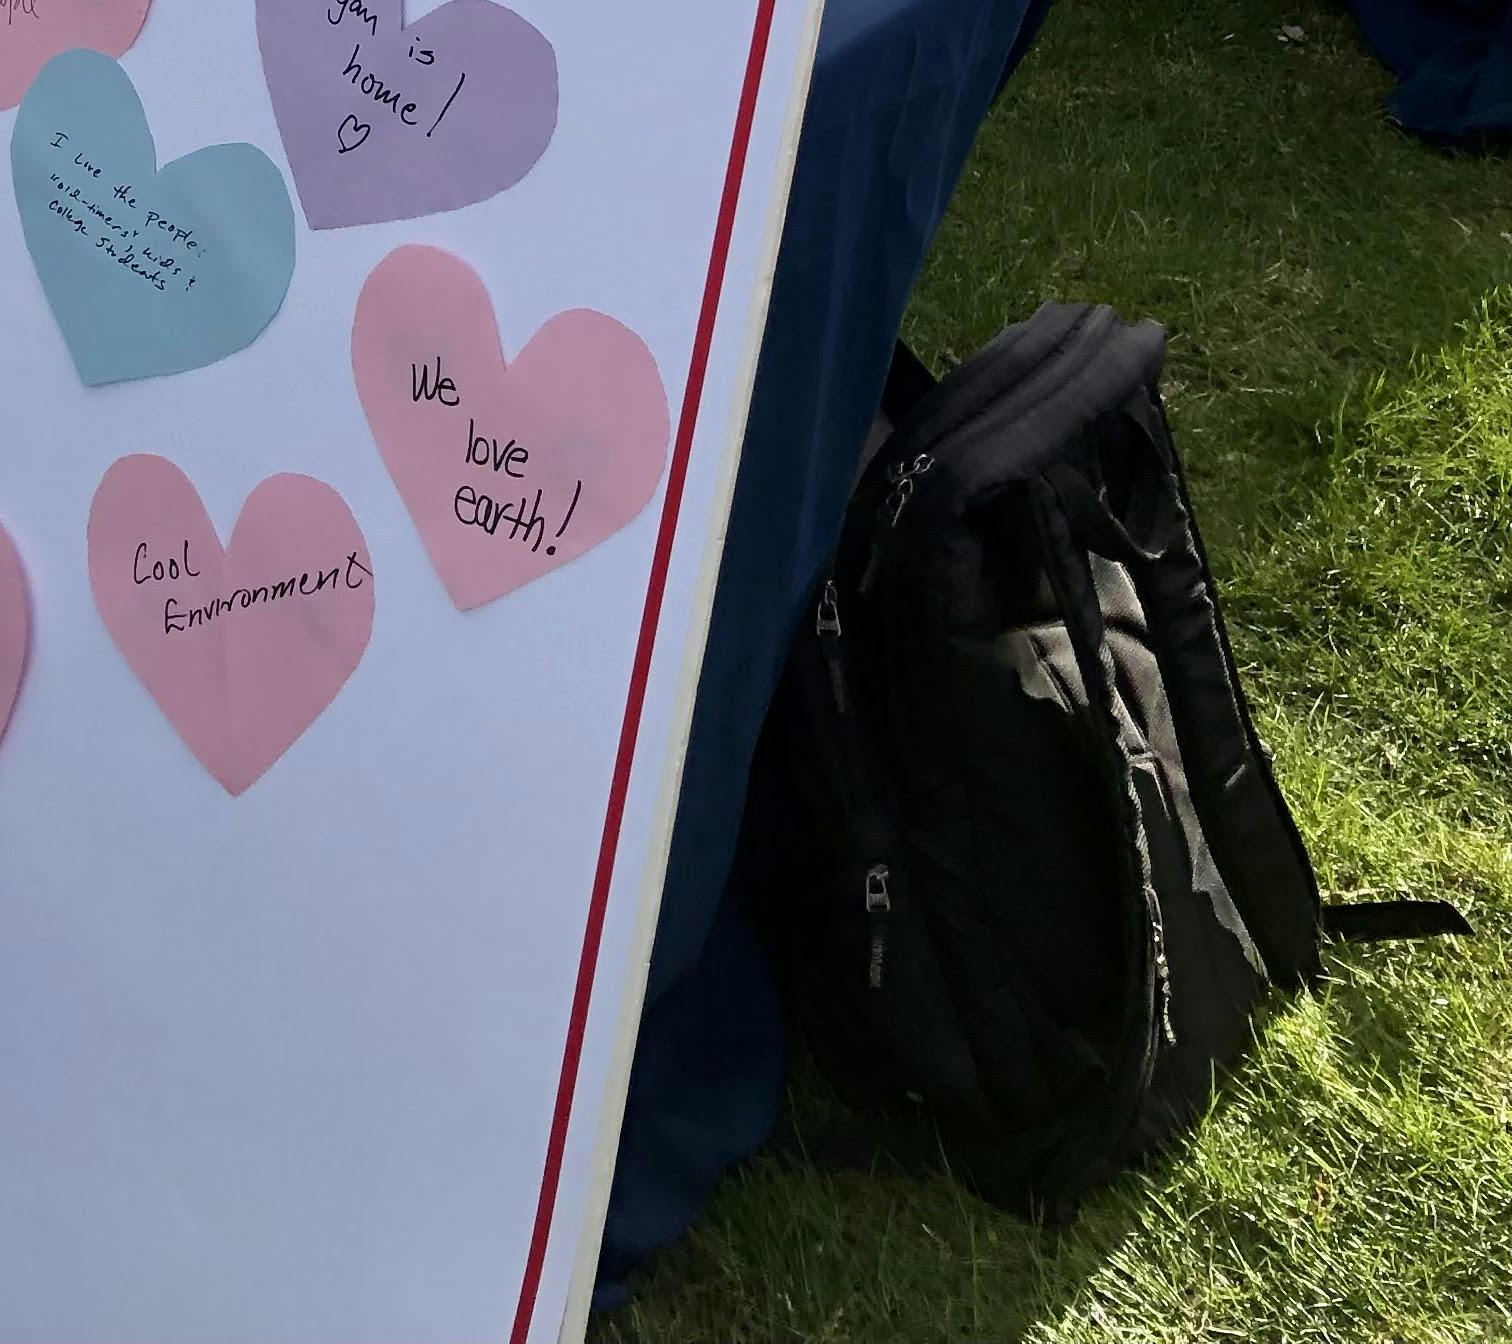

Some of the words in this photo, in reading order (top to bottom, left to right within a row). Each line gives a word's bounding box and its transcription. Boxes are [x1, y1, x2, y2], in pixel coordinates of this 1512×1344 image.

[408, 36, 436, 66] is
[342, 43, 467, 138] home!
[50, 132, 69, 149] I
[113, 185, 137, 209] the
[412, 355, 460, 407] We
[465, 418, 530, 478] love
[454, 479, 582, 557] earth!
[132, 539, 201, 586] Cool
[163, 551, 375, 635] Environment
